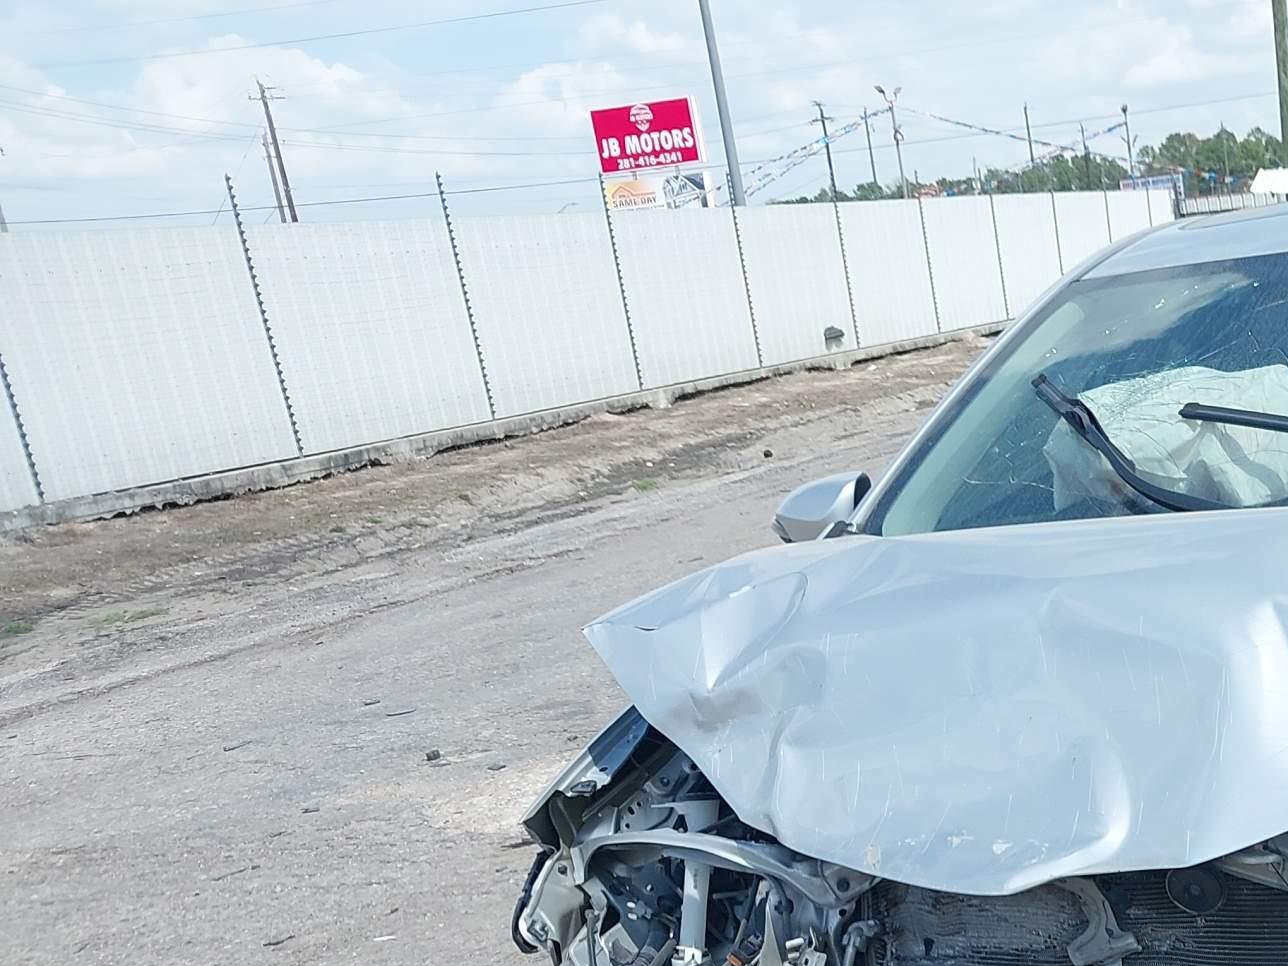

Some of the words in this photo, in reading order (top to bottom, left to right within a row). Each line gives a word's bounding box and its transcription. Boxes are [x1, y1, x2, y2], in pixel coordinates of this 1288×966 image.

[601, 138, 621, 159] JB
[624, 127, 694, 155] MOTORS
[617, 152, 683, 169] 281-416-4341
